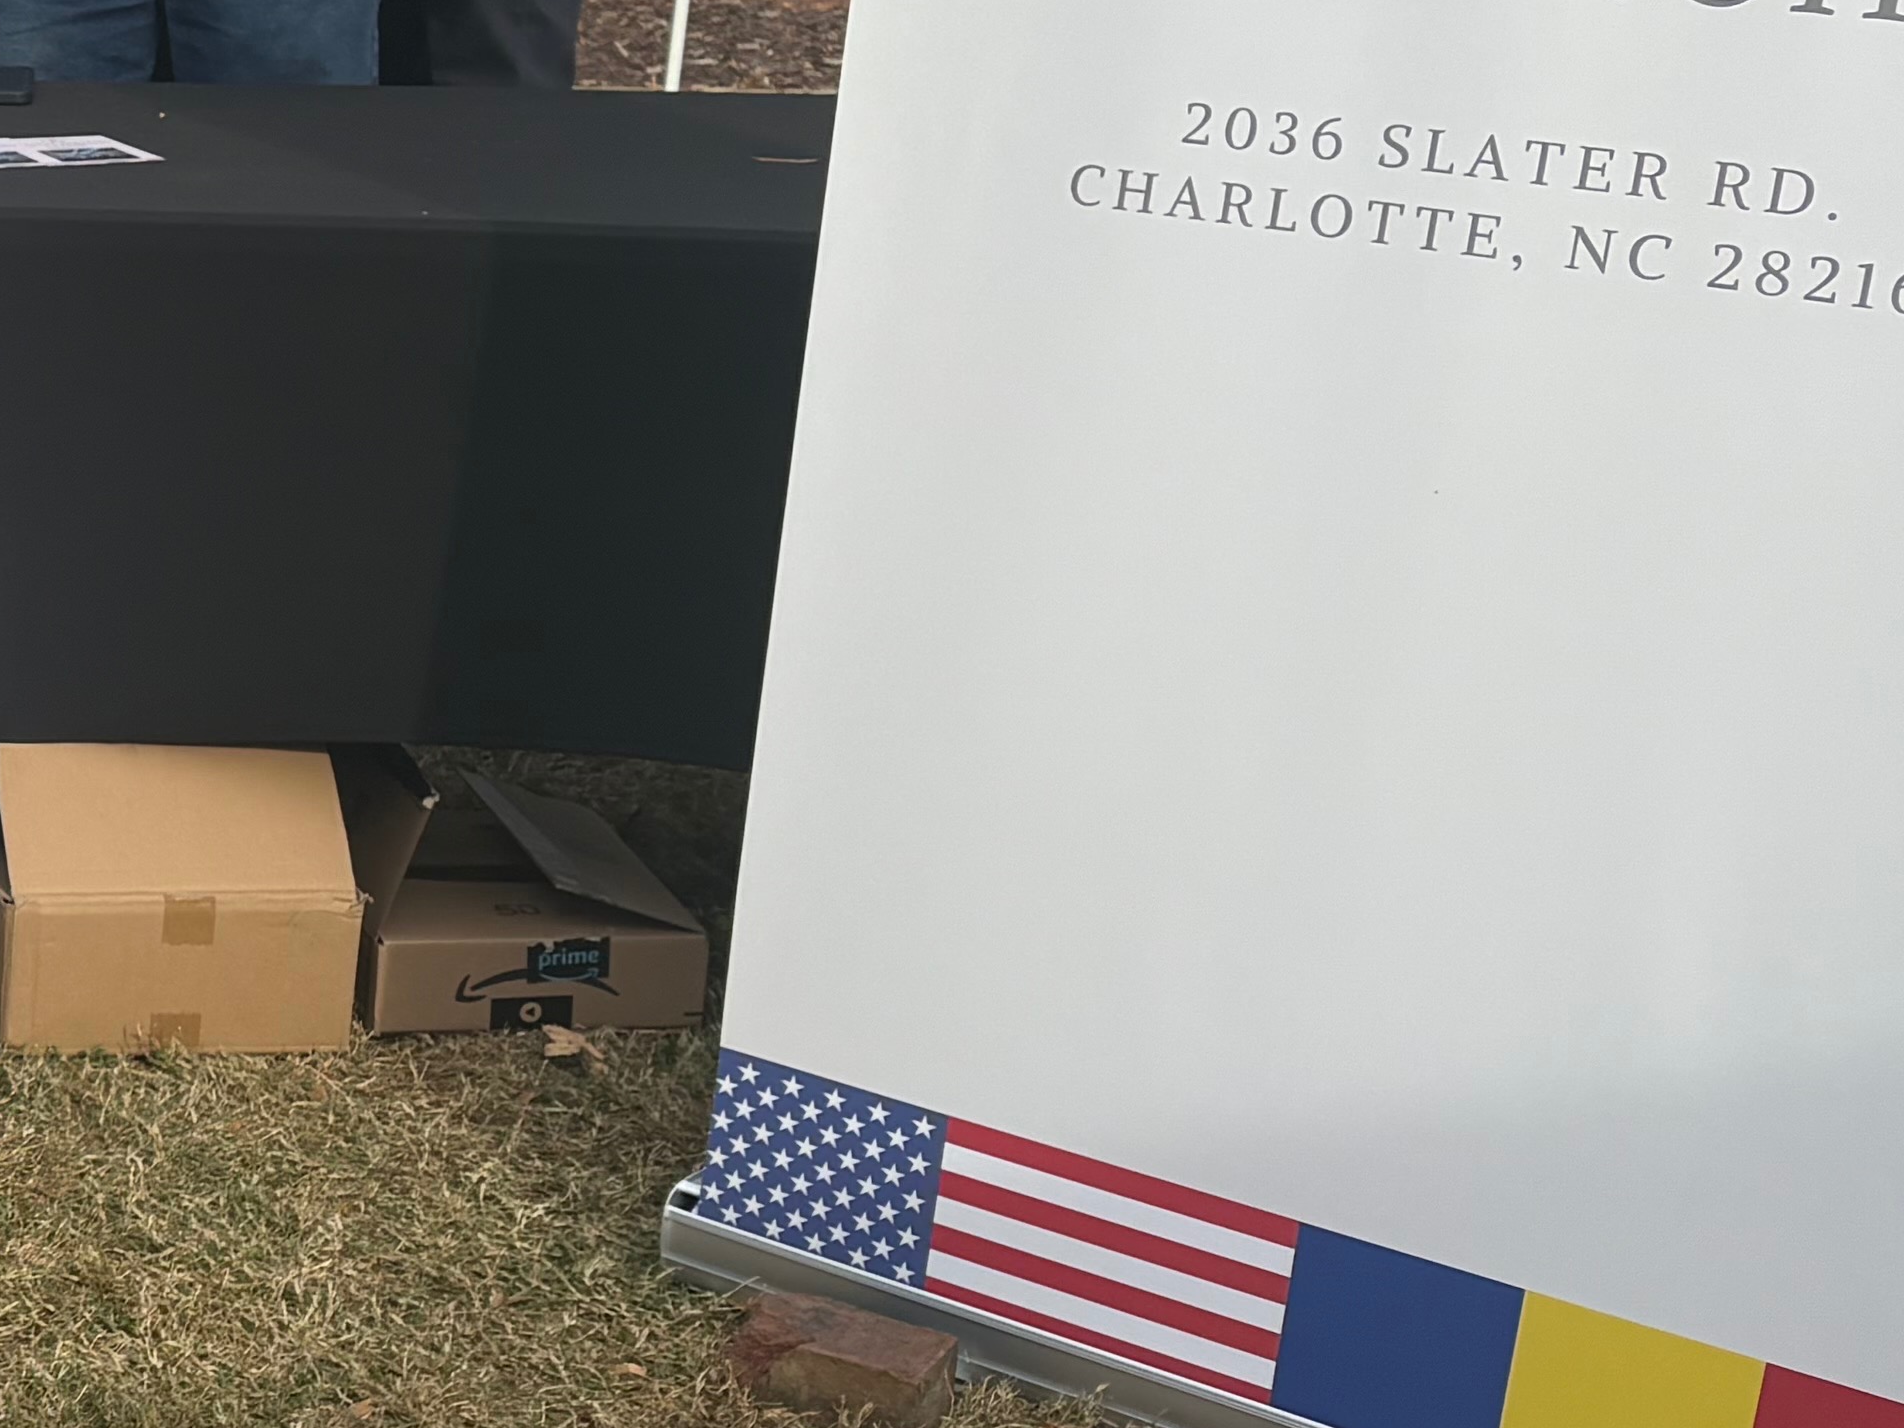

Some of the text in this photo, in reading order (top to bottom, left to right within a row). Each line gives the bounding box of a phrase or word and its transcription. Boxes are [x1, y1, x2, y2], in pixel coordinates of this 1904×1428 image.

[1182, 103, 1837, 221] 2036 SLATER RD.
[1071, 165, 1521, 270] CHARLOTTE,
[1565, 226, 1672, 280] NC
[538, 948, 599, 971] prime
